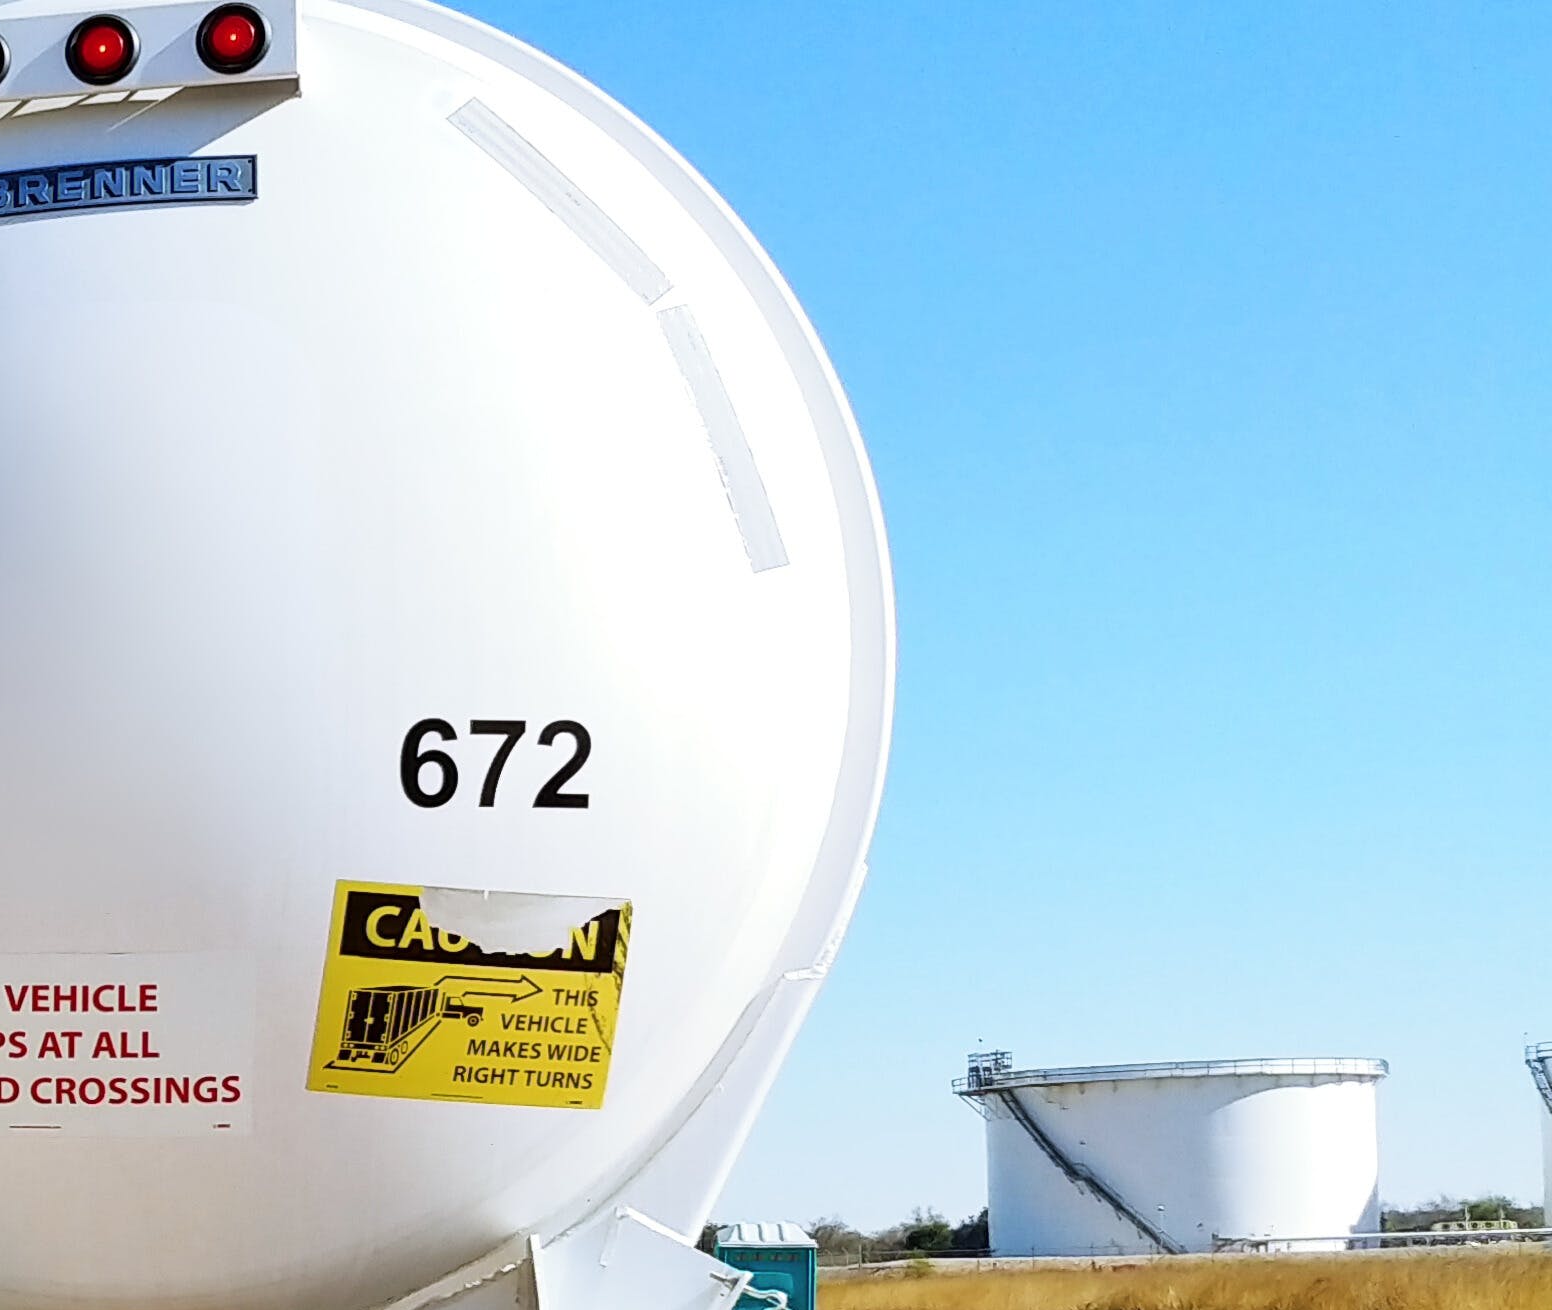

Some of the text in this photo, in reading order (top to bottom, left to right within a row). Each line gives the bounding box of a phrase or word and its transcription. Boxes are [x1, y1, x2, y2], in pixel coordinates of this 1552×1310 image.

[399, 717, 593, 809] 672
[4, 984, 159, 1013] VEHICLE
[552, 988, 599, 1007] THIS
[500, 1013, 588, 1036] VEHICLE
[37, 1030, 83, 1059] AT
[91, 1032, 161, 1059] ALL
[466, 1038, 602, 1063] MAKES WIDE
[29, 1074, 242, 1106] CROSSINGS
[452, 1065, 594, 1091] RIGHT TURNS
